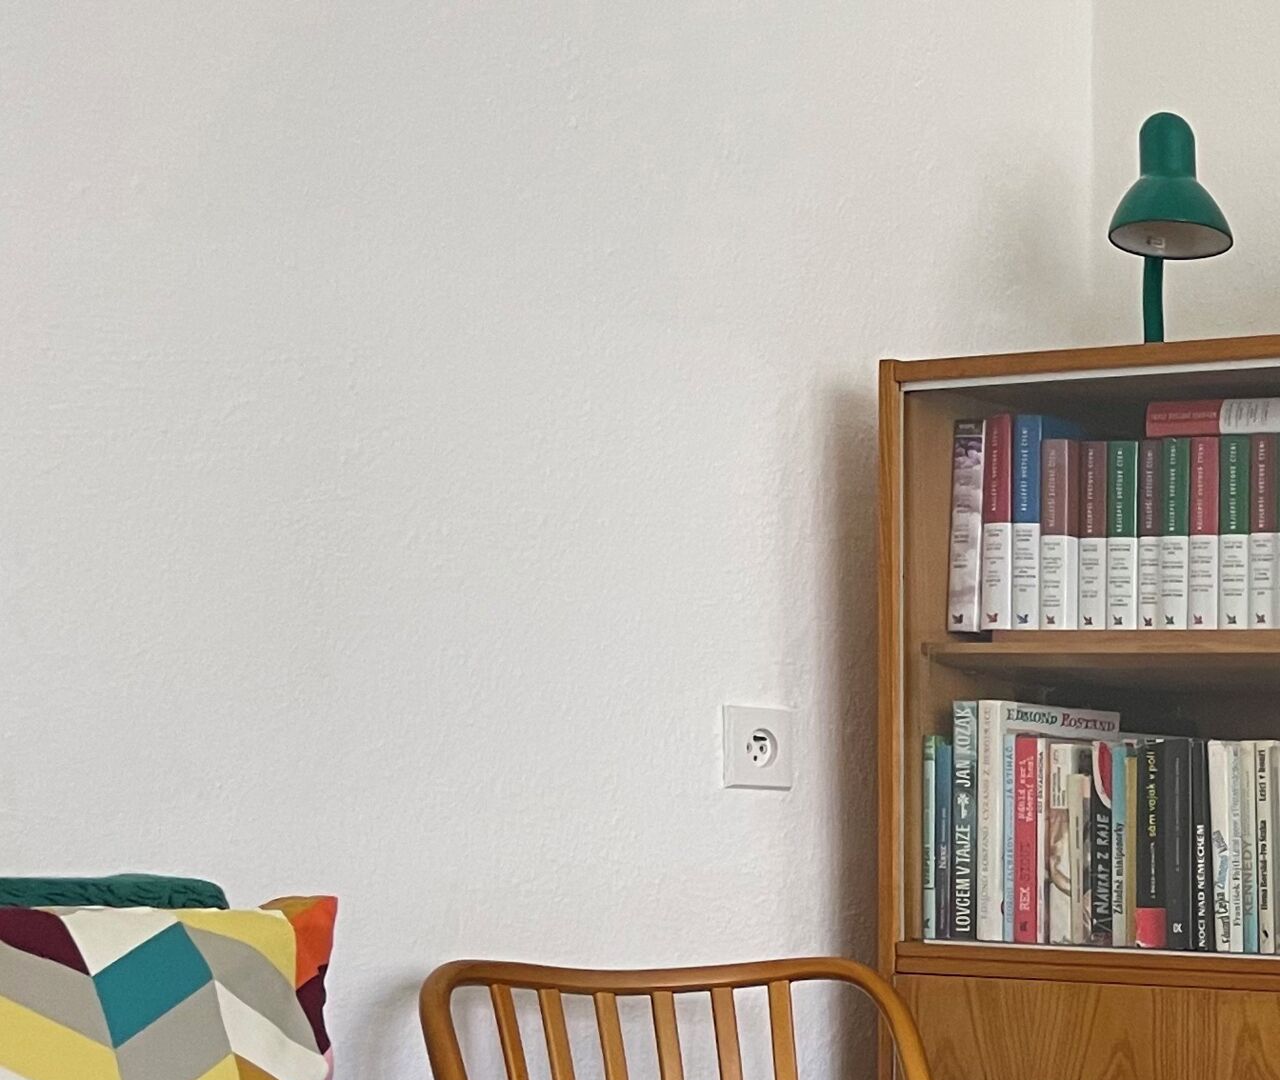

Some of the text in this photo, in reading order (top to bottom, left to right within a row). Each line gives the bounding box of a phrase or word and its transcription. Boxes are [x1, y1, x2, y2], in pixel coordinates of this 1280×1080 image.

[955, 759, 971, 787] JAN
[955, 824, 971, 932] LOVCEM V TAJZE
[1020, 886, 1030, 911] REX
